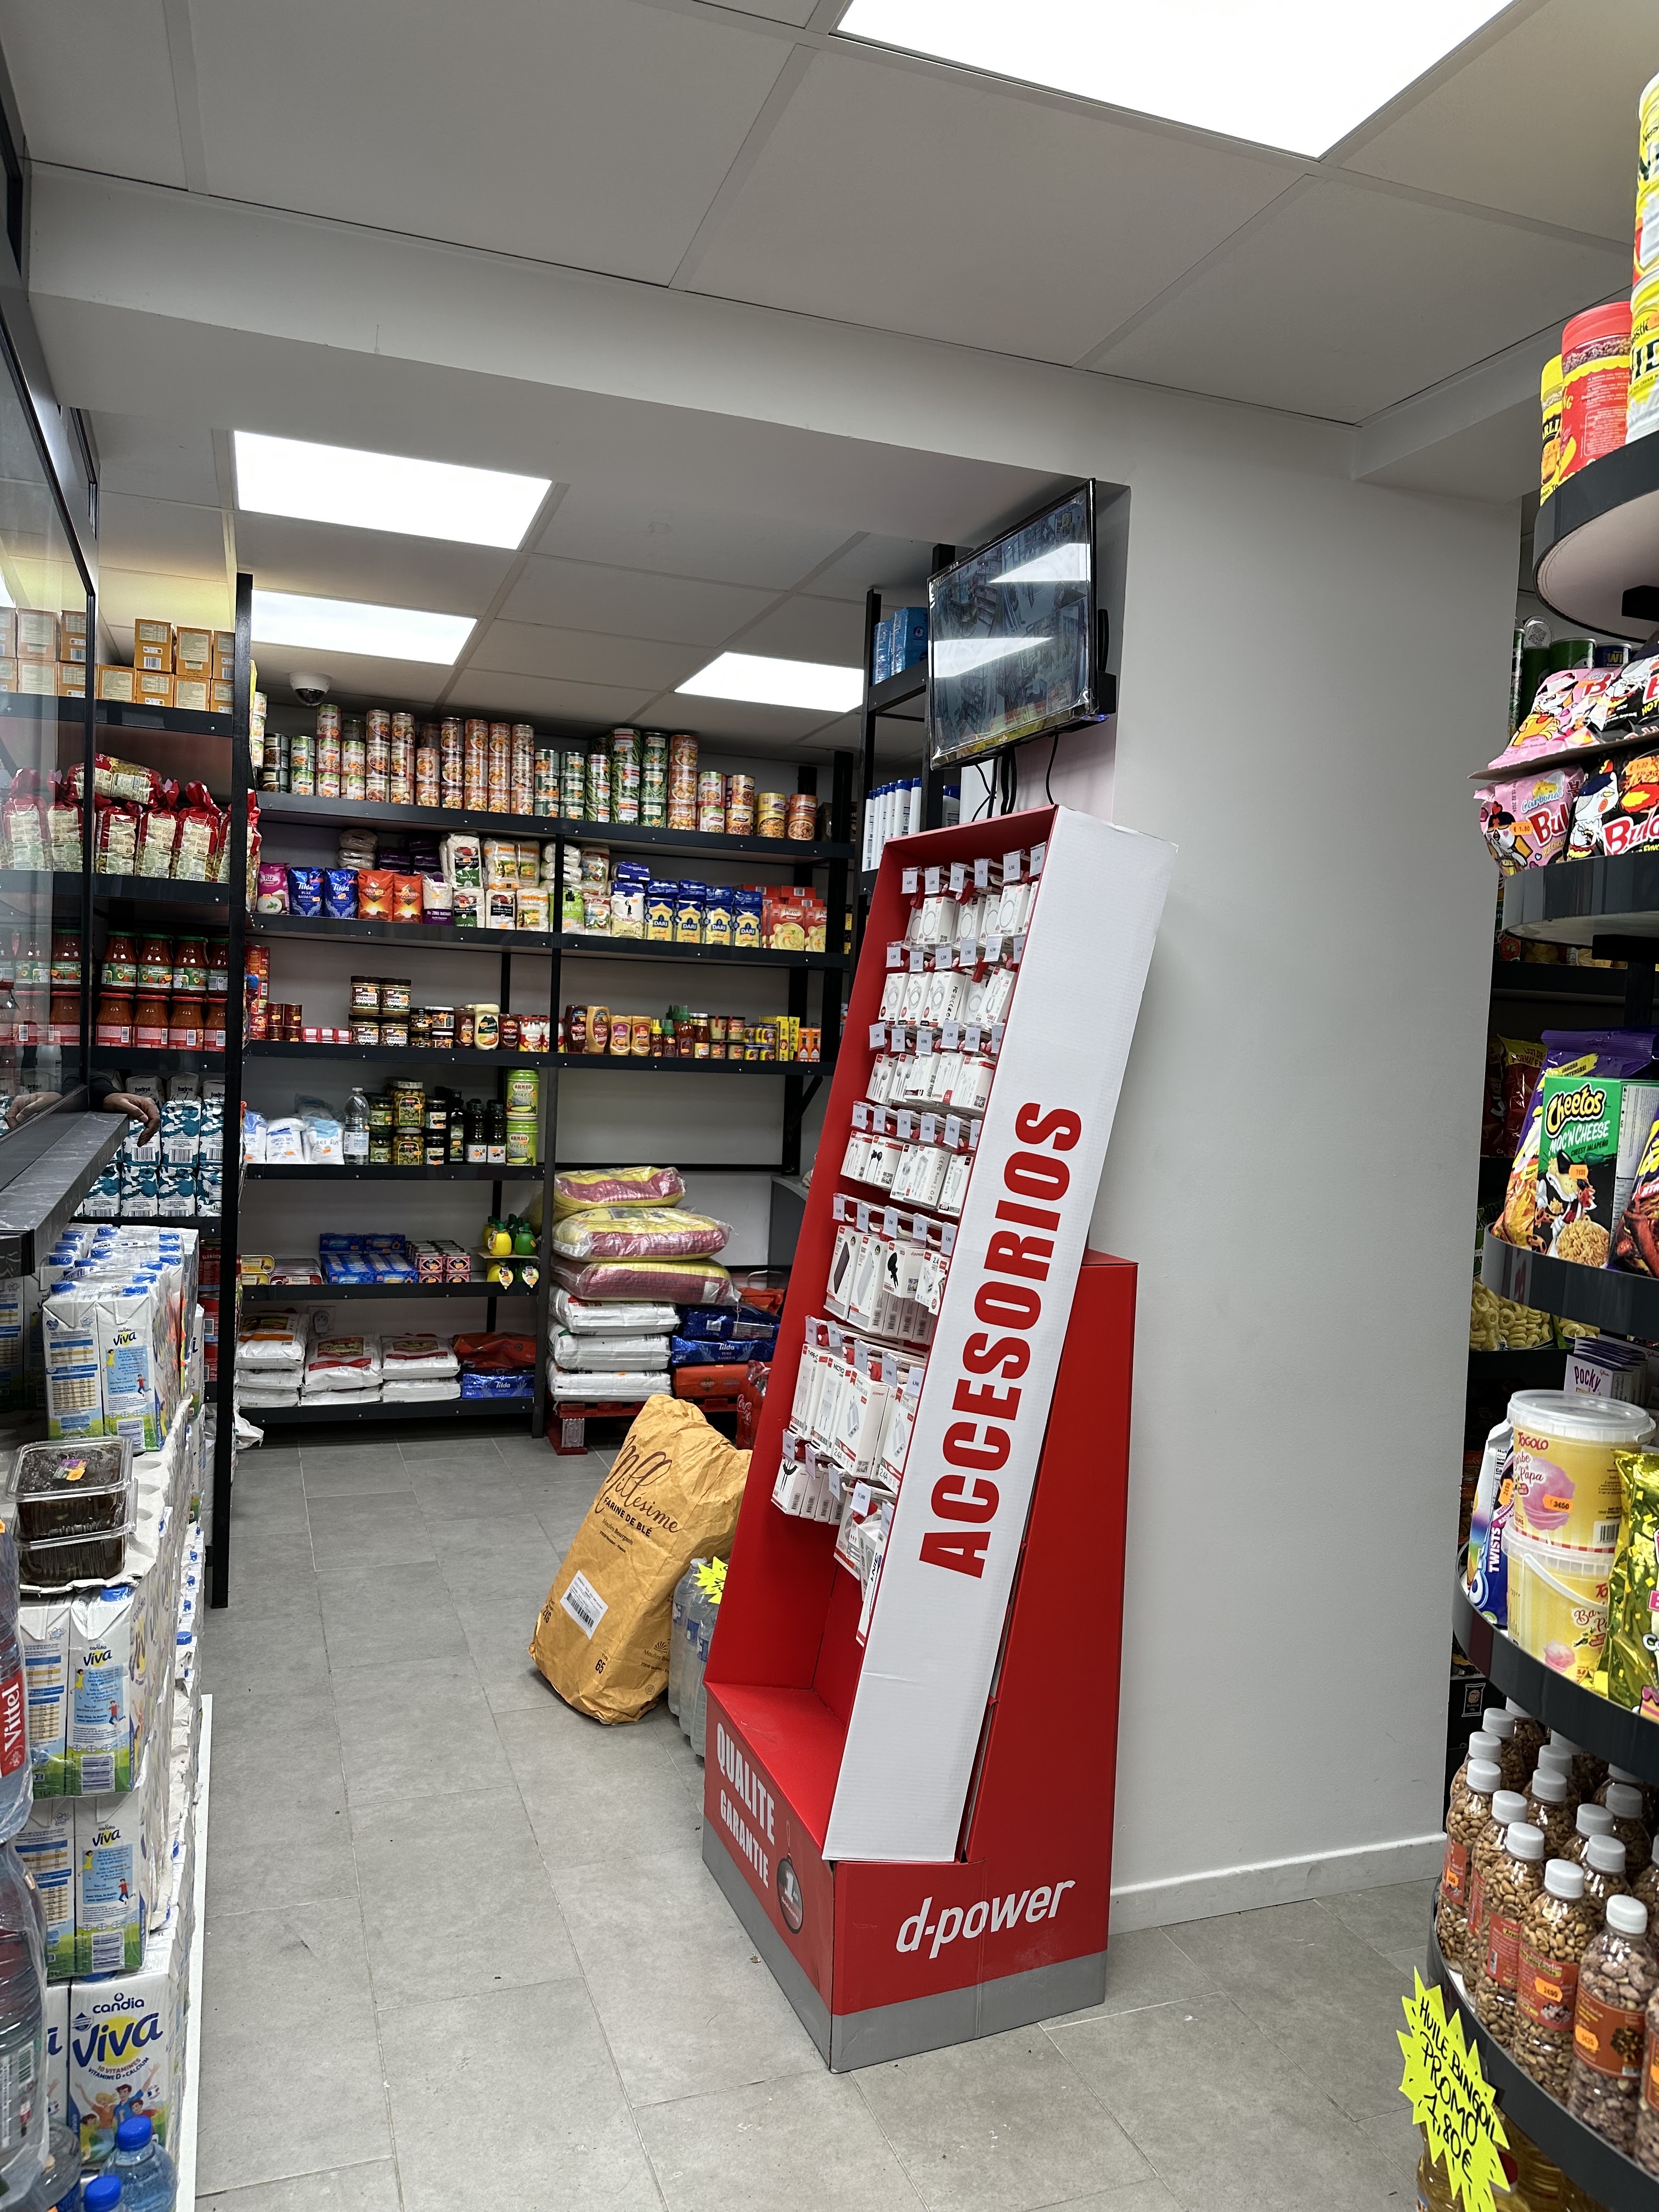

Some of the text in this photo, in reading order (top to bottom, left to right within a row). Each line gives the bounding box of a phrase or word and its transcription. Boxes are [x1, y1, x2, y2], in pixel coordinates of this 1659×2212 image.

[296, 881, 314, 890] Tilda
[331, 883, 349, 891] Tilda
[1548, 1085, 1604, 1136] Cheetos
[1575, 1120, 1610, 1147] CHEESE
[1571, 1139, 1609, 1156] CHEESY JALAPEÑO
[113, 1332, 137, 1346] Viva
[919, 1102, 1082, 1580] ACCESORIOS
[833, 1363, 845, 1374] MICRO
[1518, 1432, 1549, 1451] TOGOLO
[595, 1435, 684, 1533] Millésime
[1520, 1467, 1544, 1483] Papa
[603, 1497, 652, 1537] FARINE DE BLÉ
[614, 1528, 633, 1545] Bourgeois
[1488, 1527, 1501, 1573] TWISTS
[83, 1650, 112, 1666] Viva
[643, 1649, 661, 1661] Moulins
[595, 1660, 605, 1674] 65
[1, 1681, 21, 1752] Vittel
[716, 1722, 775, 1846] QUALITE
[92, 1829, 121, 1847] Viva
[720, 1789, 769, 1889] GARANTIE
[784, 1869, 793, 1905] 1
[895, 1880, 1076, 1959] d-power
[93, 1997, 144, 2014] candia
[72, 2012, 163, 2067] Viva
[1419, 1996, 1448, 2061] HUILE
[88, 2067, 114, 2080] VITAMINE
[126, 2057, 150, 2076] CALCIUM
[105, 2058, 141, 2074] VITAMINES
[1420, 2031, 1479, 2147] PROMO
